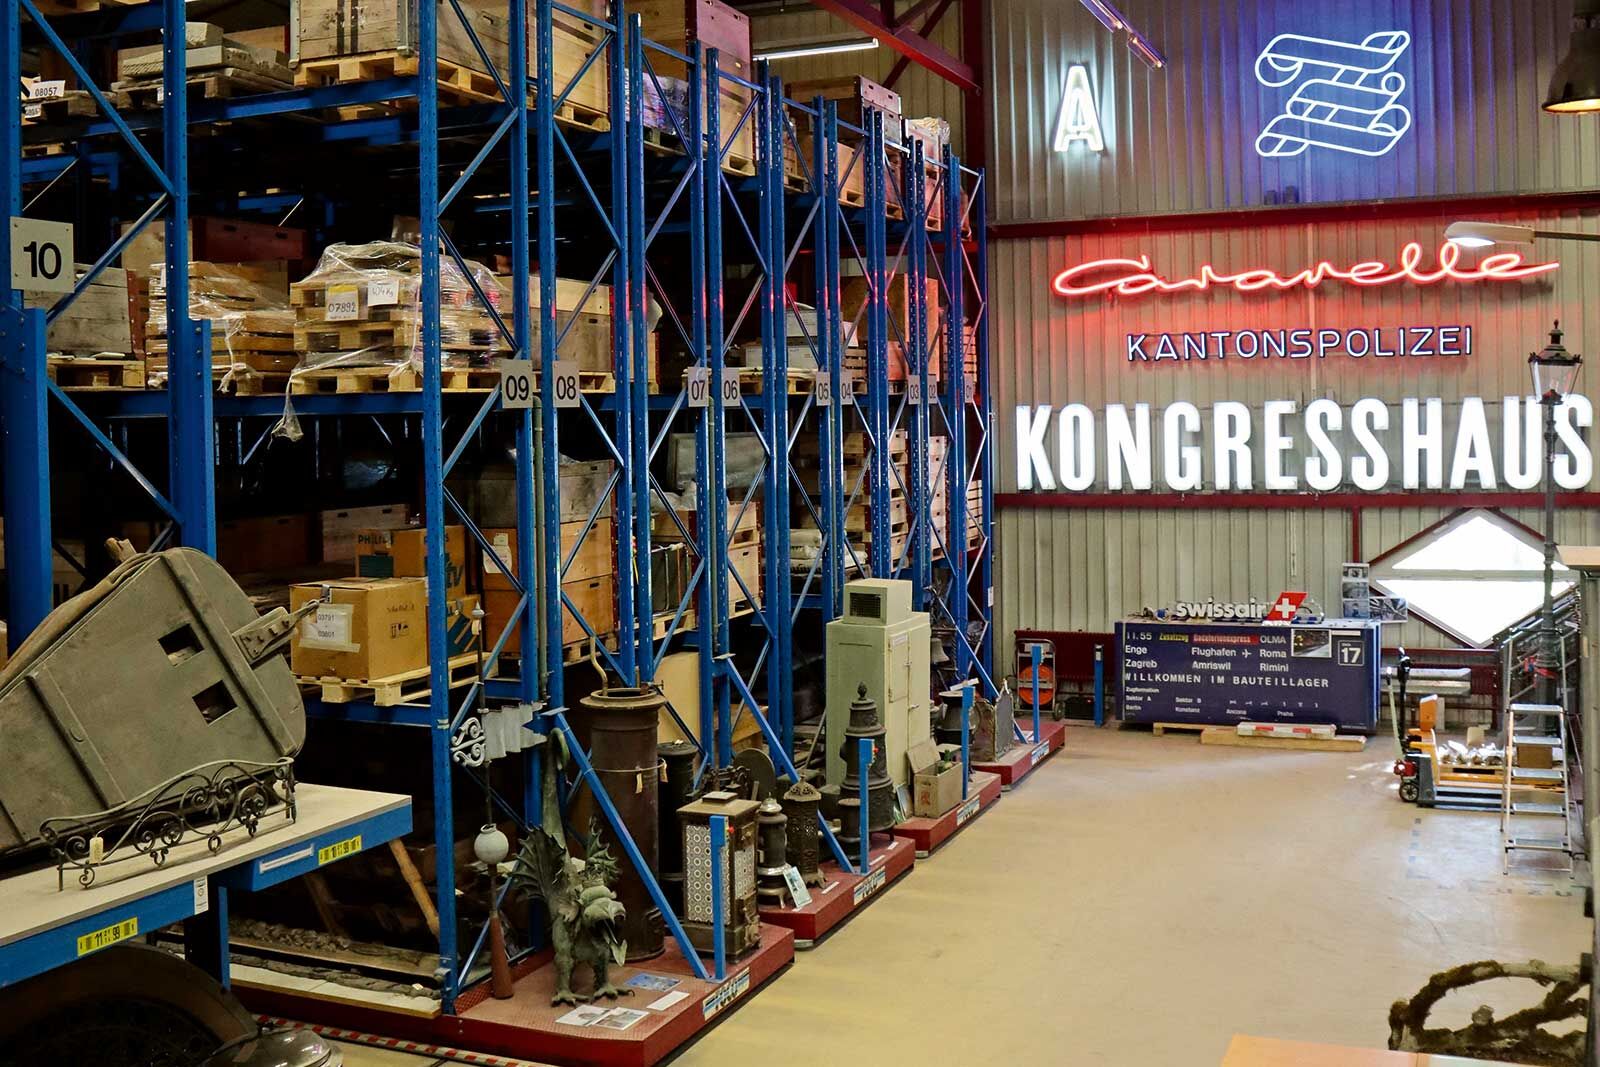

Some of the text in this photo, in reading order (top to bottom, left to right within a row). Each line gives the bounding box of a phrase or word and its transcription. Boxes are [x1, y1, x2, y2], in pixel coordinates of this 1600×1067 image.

[35, 87, 57, 97] 08057
[1054, 65, 1104, 152] A
[23, 241, 63, 280] 10
[1053, 241, 1560, 296] Caravelle
[328, 302, 356, 313] 07892
[1127, 326, 1473, 361] KANTONSPOLIZEI
[506, 375, 530, 401] 09
[556, 375, 577, 400] 08
[692, 380, 706, 400] 07
[724, 379, 738, 399] 06
[817, 383, 829, 399] 05
[841, 383, 852, 399] 04
[910, 383, 919, 400] 03
[1015, 394, 1593, 493] KONGRESSHAUS
[1175, 597, 1266, 618] swissair
[1259, 635, 1287, 644] OLMA
[1125, 645, 1287, 658] Enge Flughafen Roma
[1341, 647, 1361, 664] 17
[1125, 659, 1290, 672] Zagreb Amriswil Rimini
[1124, 672, 1330, 689] WILLKOMMEN IM BAUTEILLAGER
